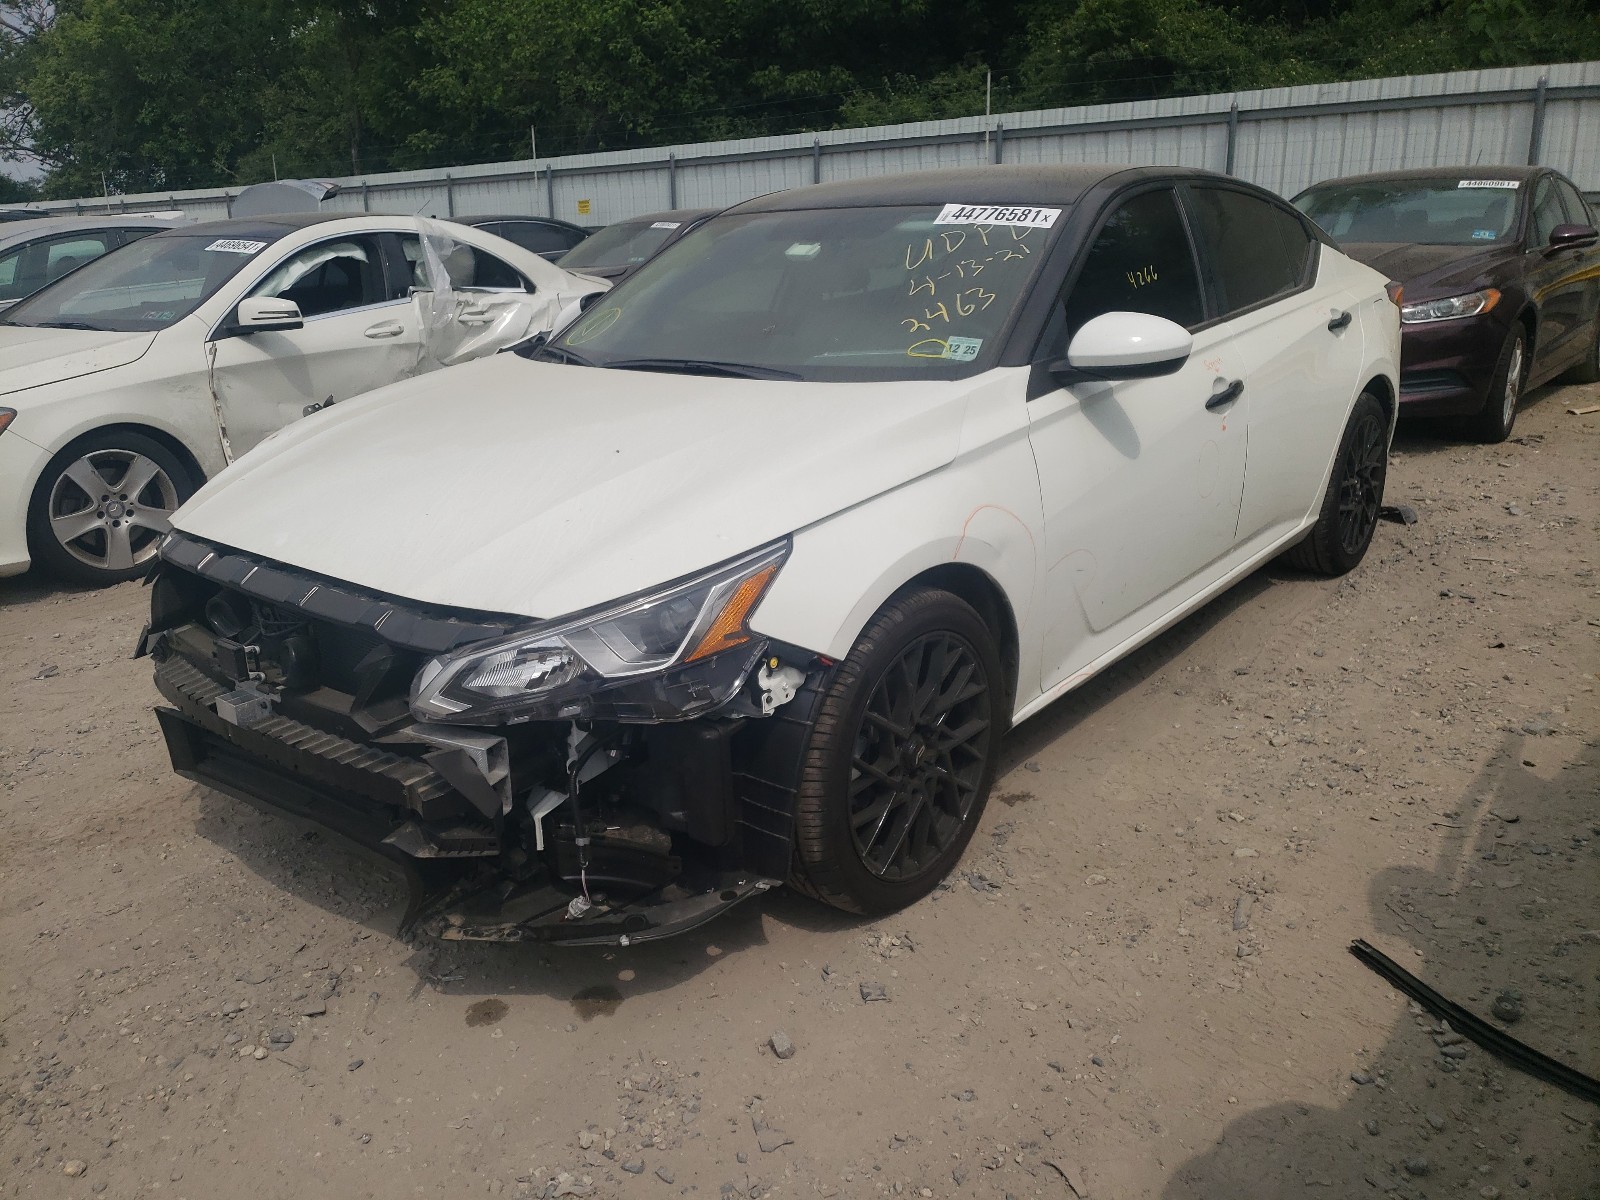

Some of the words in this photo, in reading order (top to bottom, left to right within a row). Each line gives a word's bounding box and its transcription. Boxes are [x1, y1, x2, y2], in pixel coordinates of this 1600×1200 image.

[951, 206, 1042, 223] 44776581
[1126, 264, 1158, 289] 4266
[963, 345, 977, 355] 25
